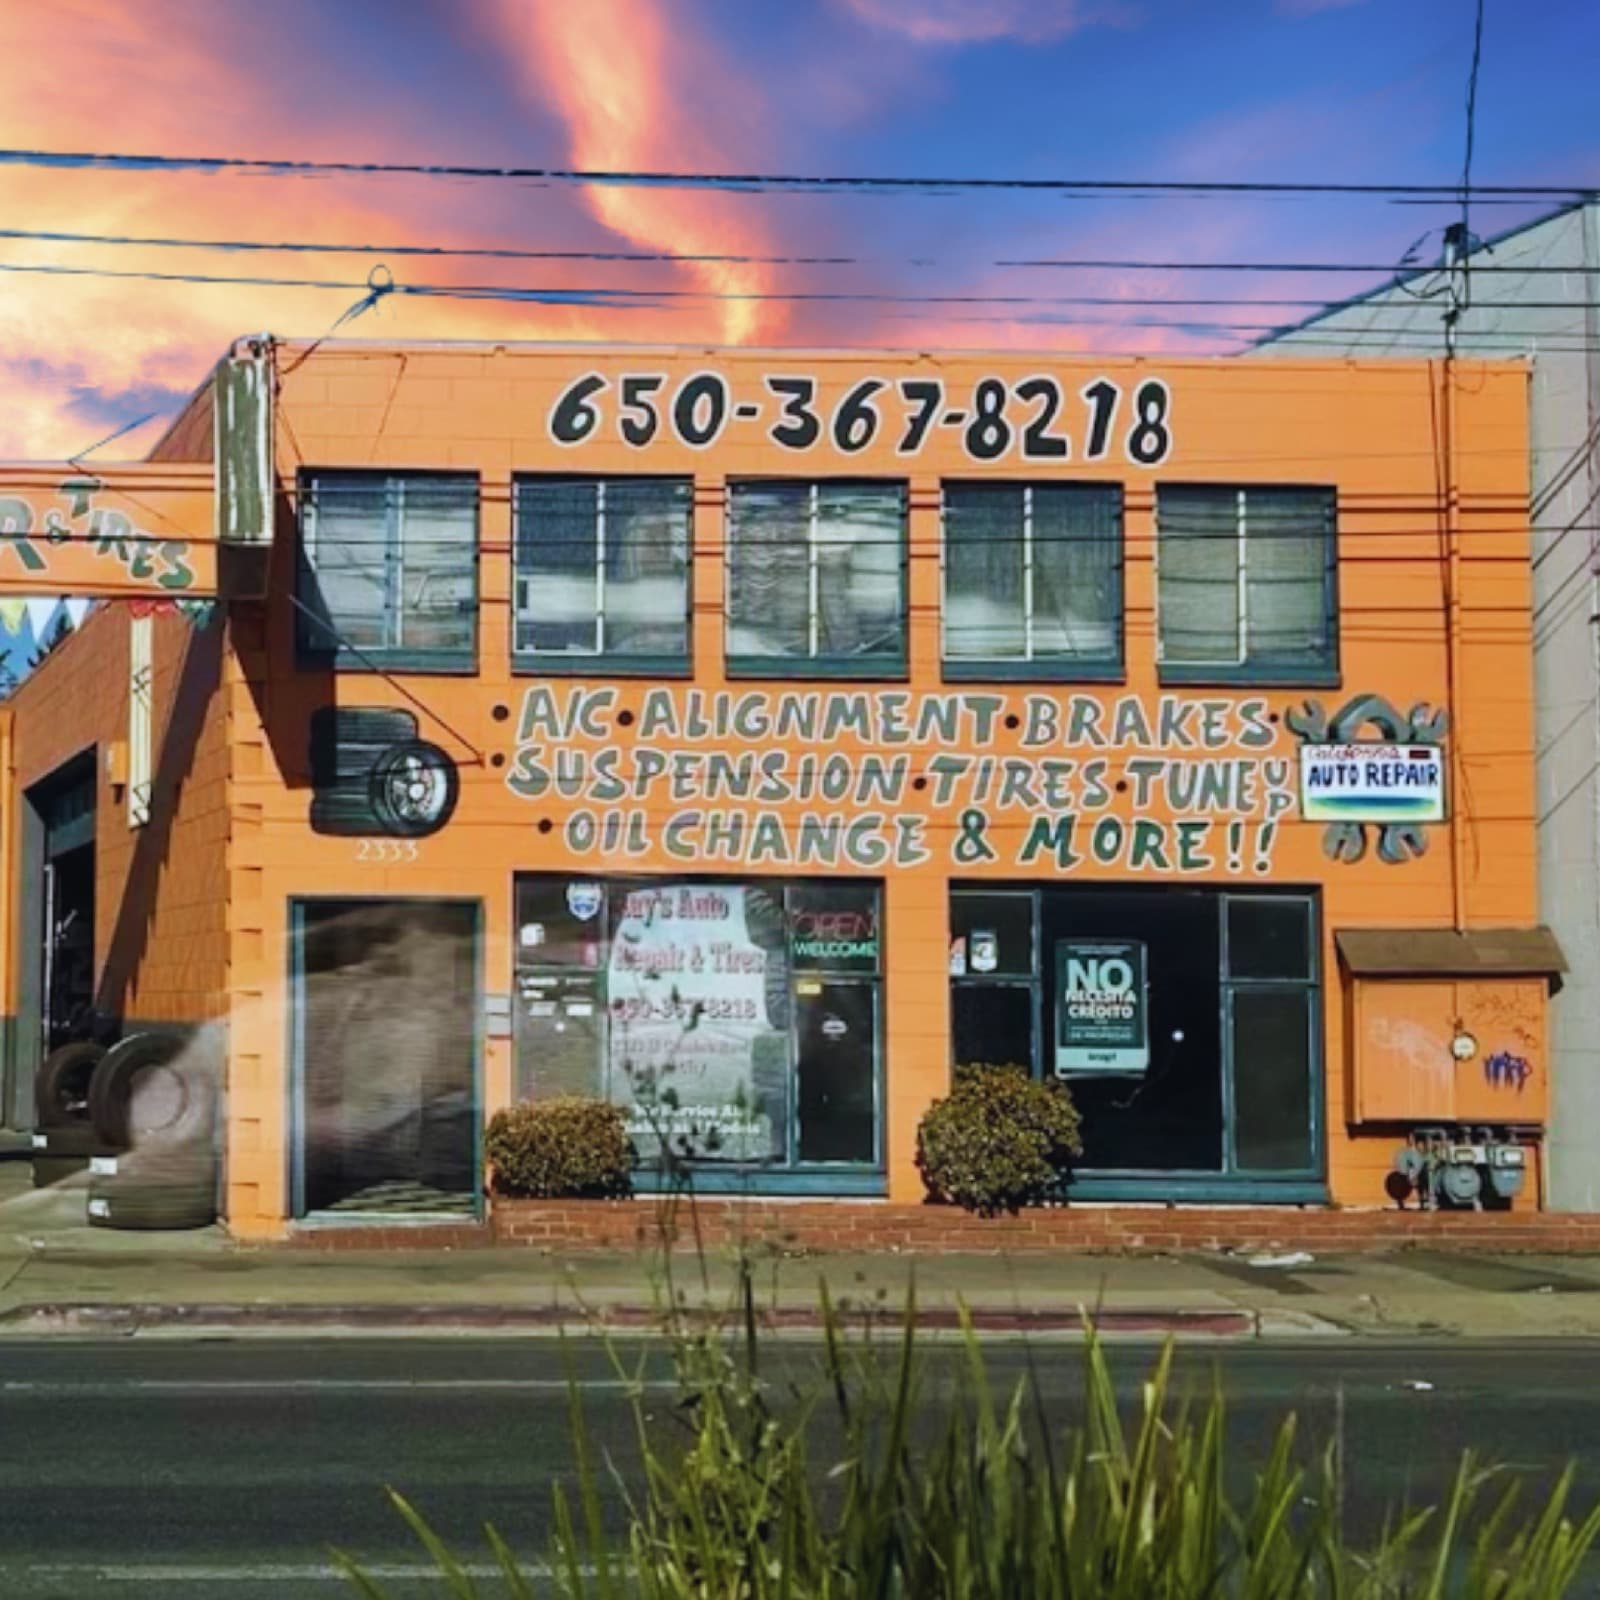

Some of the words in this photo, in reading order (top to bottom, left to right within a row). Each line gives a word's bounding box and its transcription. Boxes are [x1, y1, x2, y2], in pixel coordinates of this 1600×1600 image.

[548, 372, 1172, 465] 650-367-8218
[58, 476, 197, 593] TIRES
[517, 685, 617, 743] A/C
[639, 687, 1002, 746] ALIGNMENT
[1019, 693, 1279, 750] BRAKES
[506, 745, 909, 806] SUSPENSION
[926, 754, 1111, 811] TIRES
[1126, 758, 1260, 813] TUNE
[1308, 763, 1360, 788] AUTO
[1365, 761, 1439, 788] REPAIR
[564, 808, 652, 856] OIL
[664, 810, 930, 866] CHANGE
[953, 806, 998, 866] &
[793, 910, 874, 938] OPEN
[794, 941, 877, 957] WELCOME
[1066, 958, 1134, 992] NO
